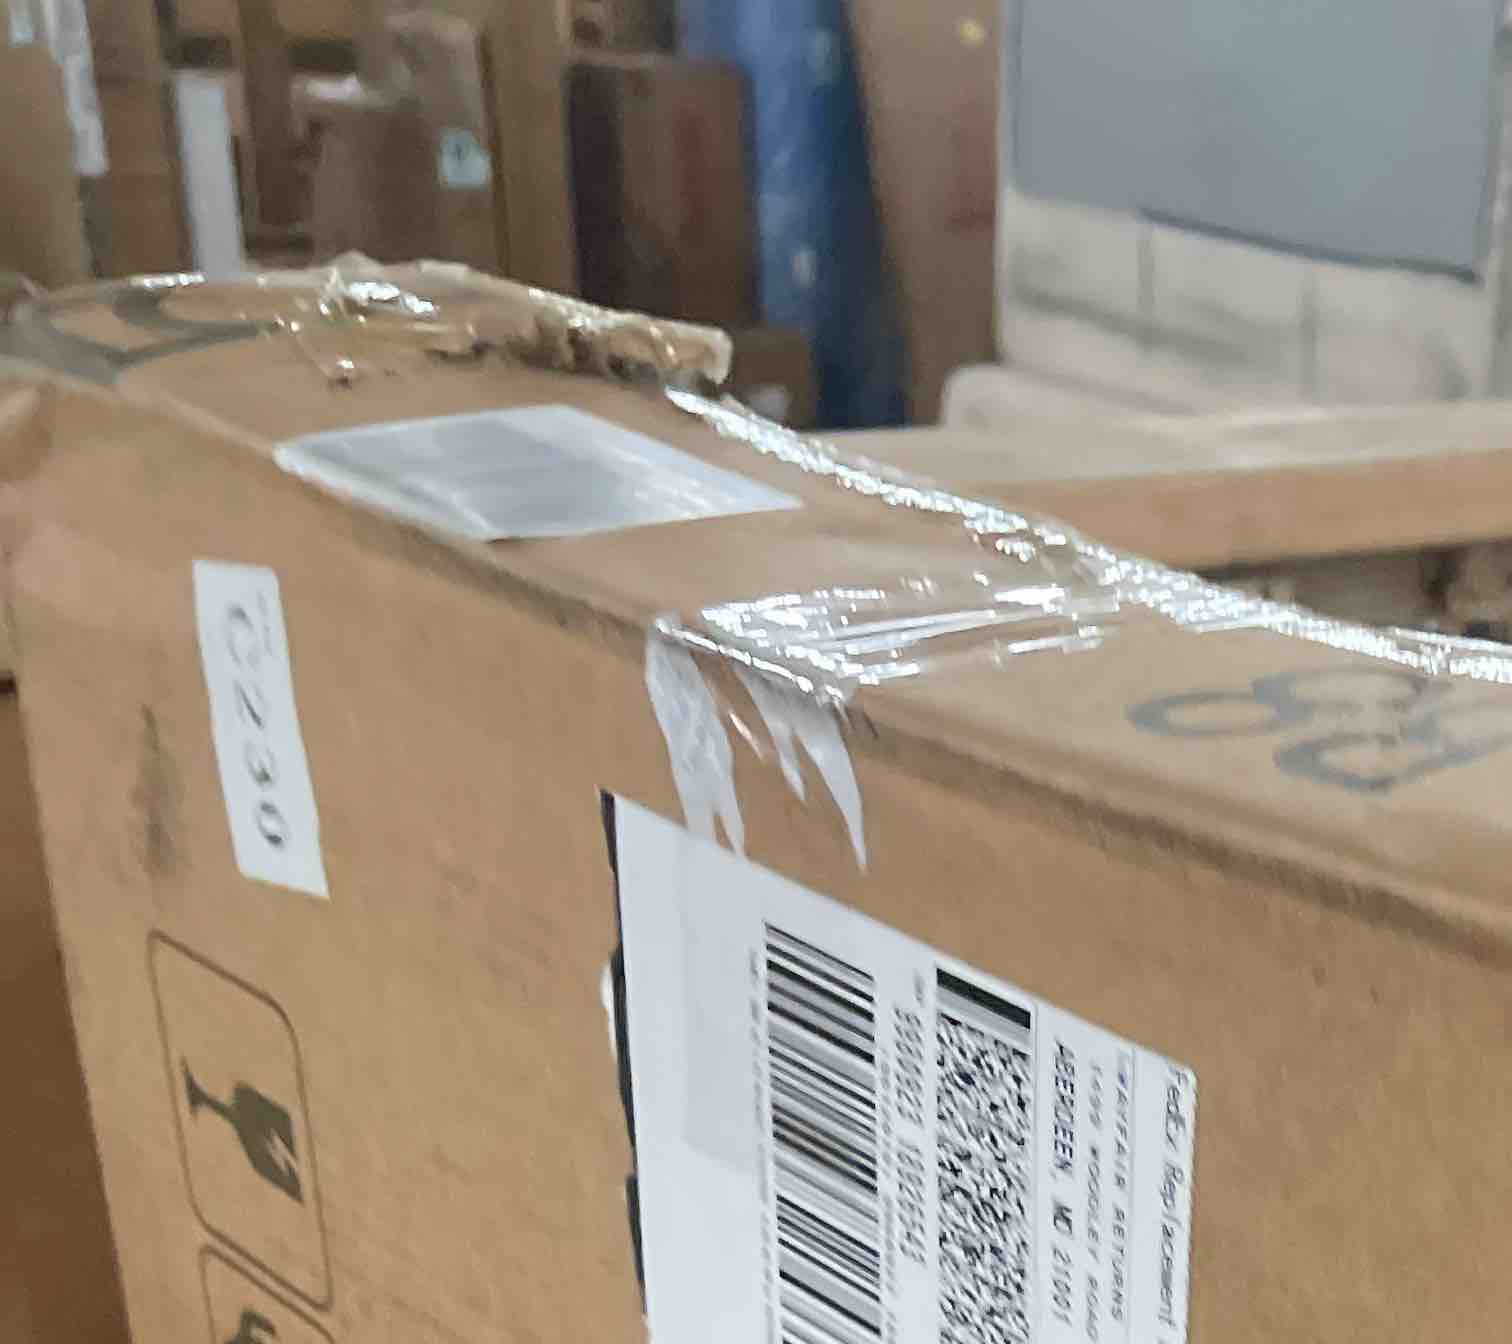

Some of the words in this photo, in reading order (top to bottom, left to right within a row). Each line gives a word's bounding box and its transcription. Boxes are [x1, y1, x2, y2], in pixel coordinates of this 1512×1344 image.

[1053, 1200, 1074, 1237] MD
[1052, 1247, 1073, 1328] 21001
[1110, 1203, 1127, 1323] RETURNS
[1084, 1273, 1100, 1344] ROAD
